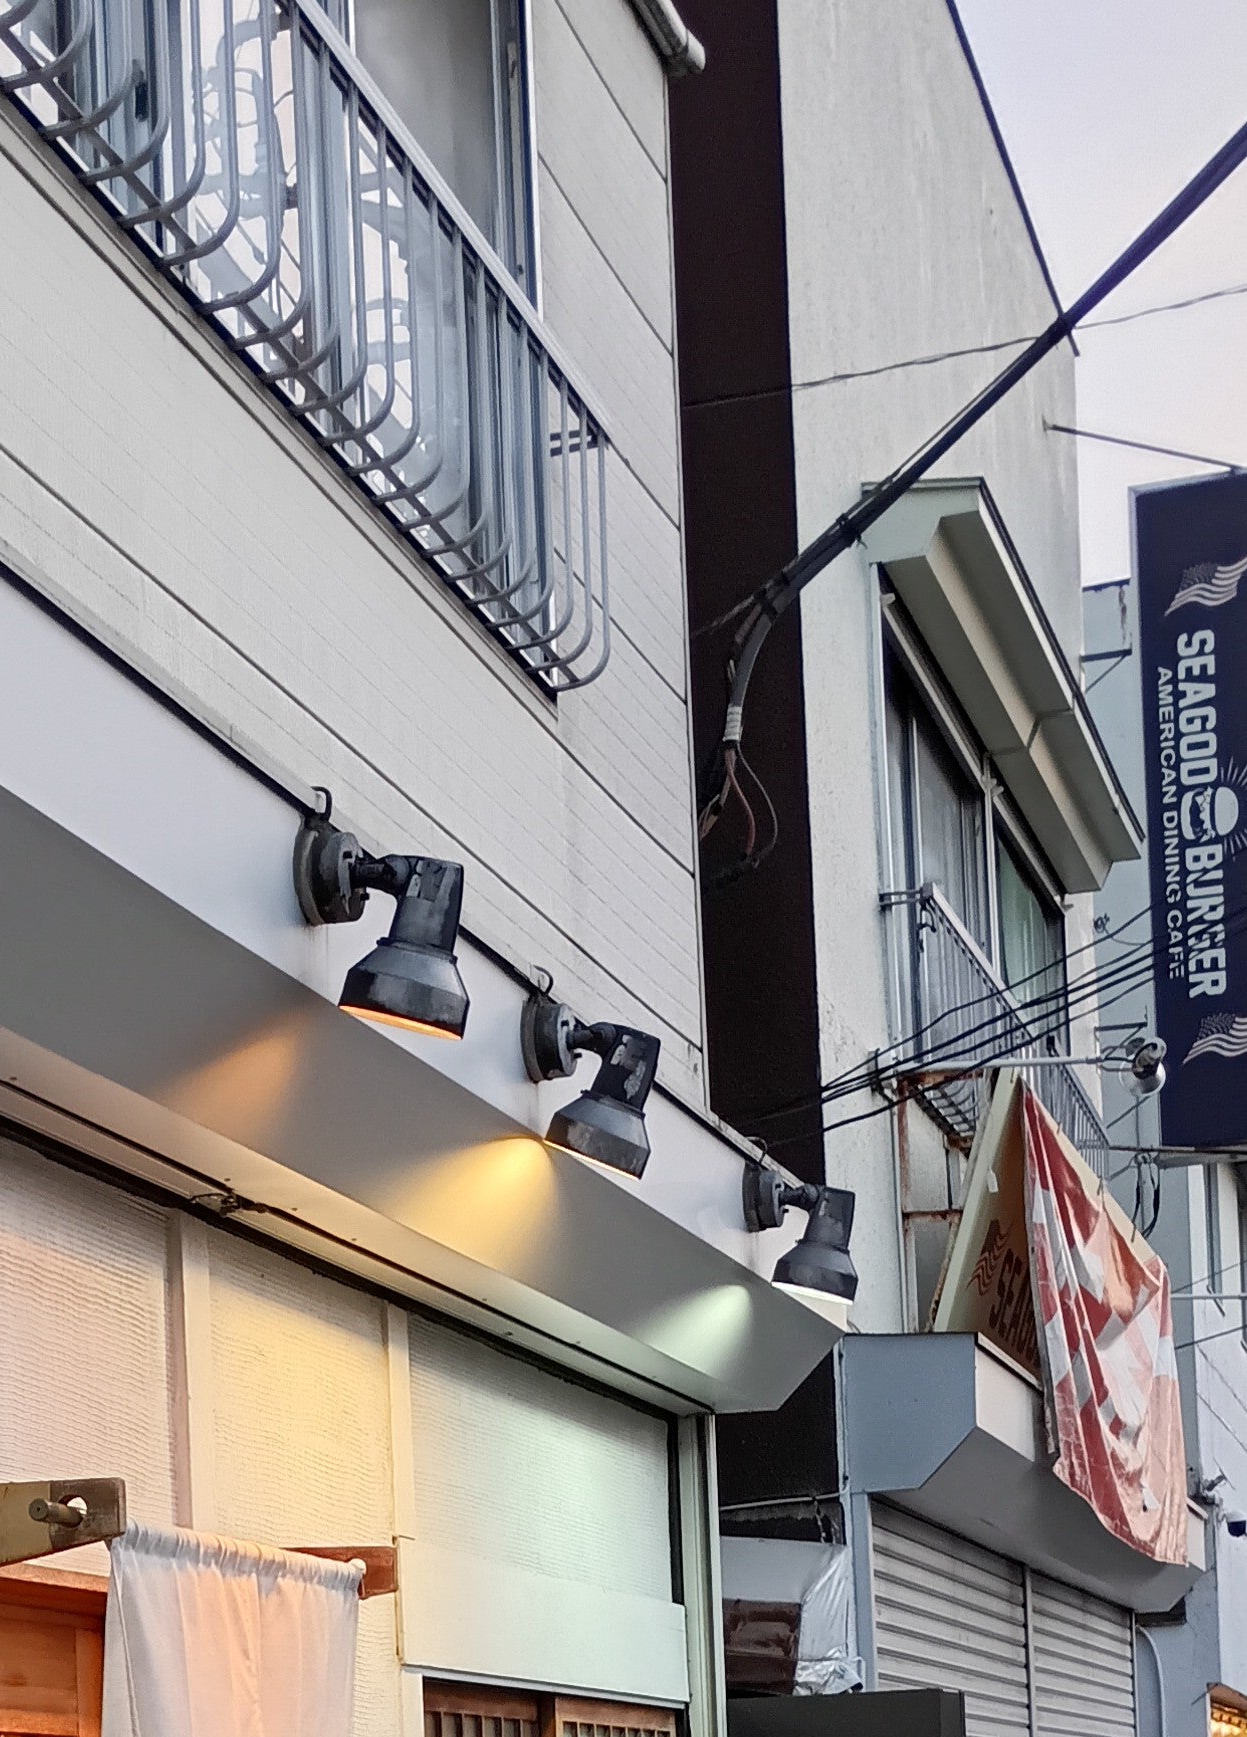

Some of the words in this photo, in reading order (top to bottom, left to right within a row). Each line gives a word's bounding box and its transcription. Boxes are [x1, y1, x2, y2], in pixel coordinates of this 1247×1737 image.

[1157, 666, 1178, 804] AMERICAN
[1176, 629, 1218, 786] SEAGOD
[1162, 811, 1182, 903] DINING
[1185, 843, 1227, 998] BURGER
[1166, 910, 1185, 980] CAFE
